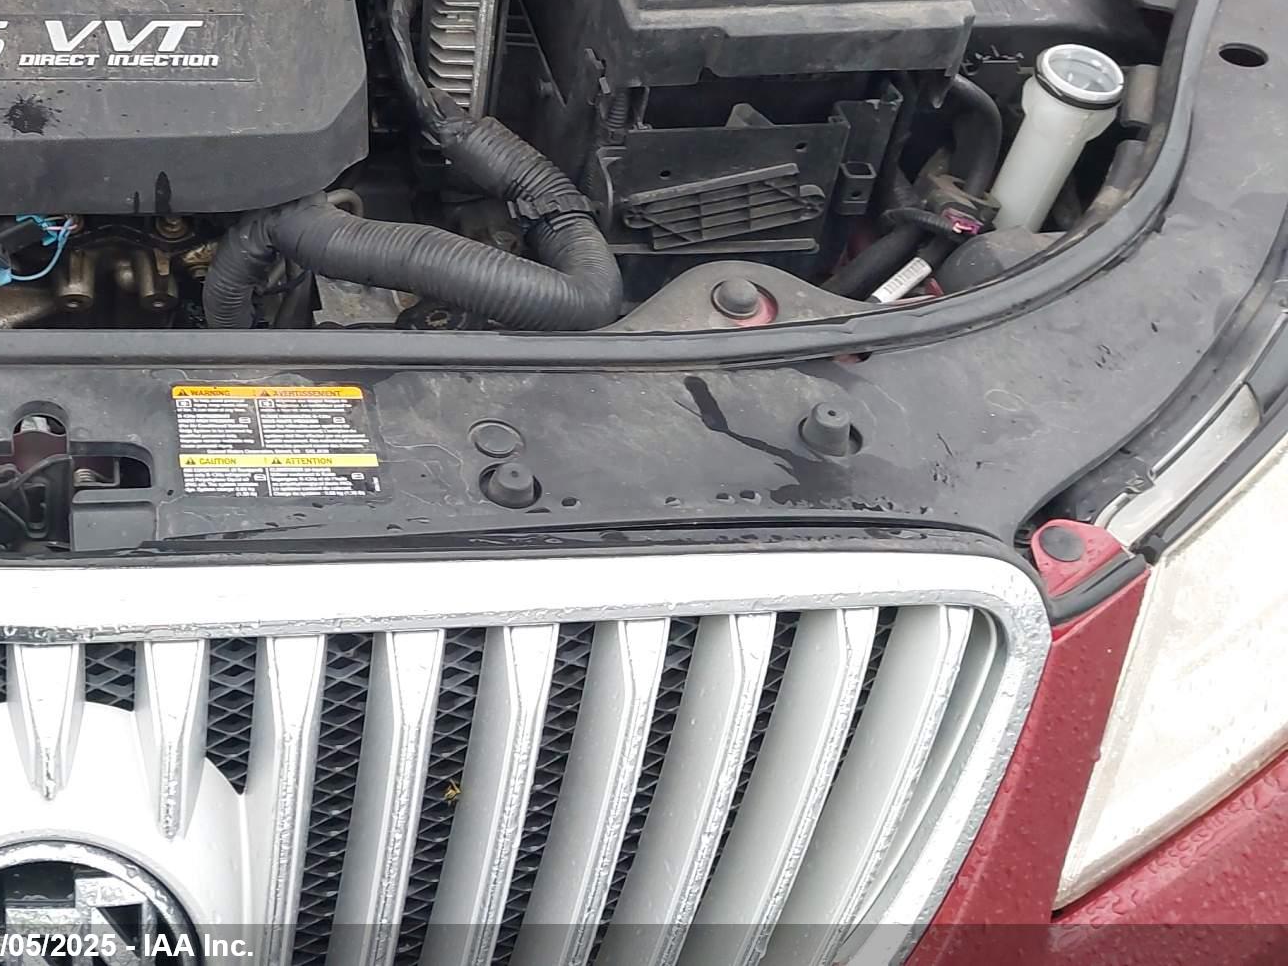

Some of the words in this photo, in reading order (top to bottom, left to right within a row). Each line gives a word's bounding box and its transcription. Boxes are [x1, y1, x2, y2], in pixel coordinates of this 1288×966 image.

[45, 20, 204, 52] VVT
[19, 54, 100, 67] DIRECT
[108, 54, 219, 67] INJECTION
[189, 389, 231, 397] WARNING
[273, 389, 342, 397] AVERTISSEMENT
[199, 457, 237, 465] CAUTION
[285, 457, 333, 465] ATTENTION
